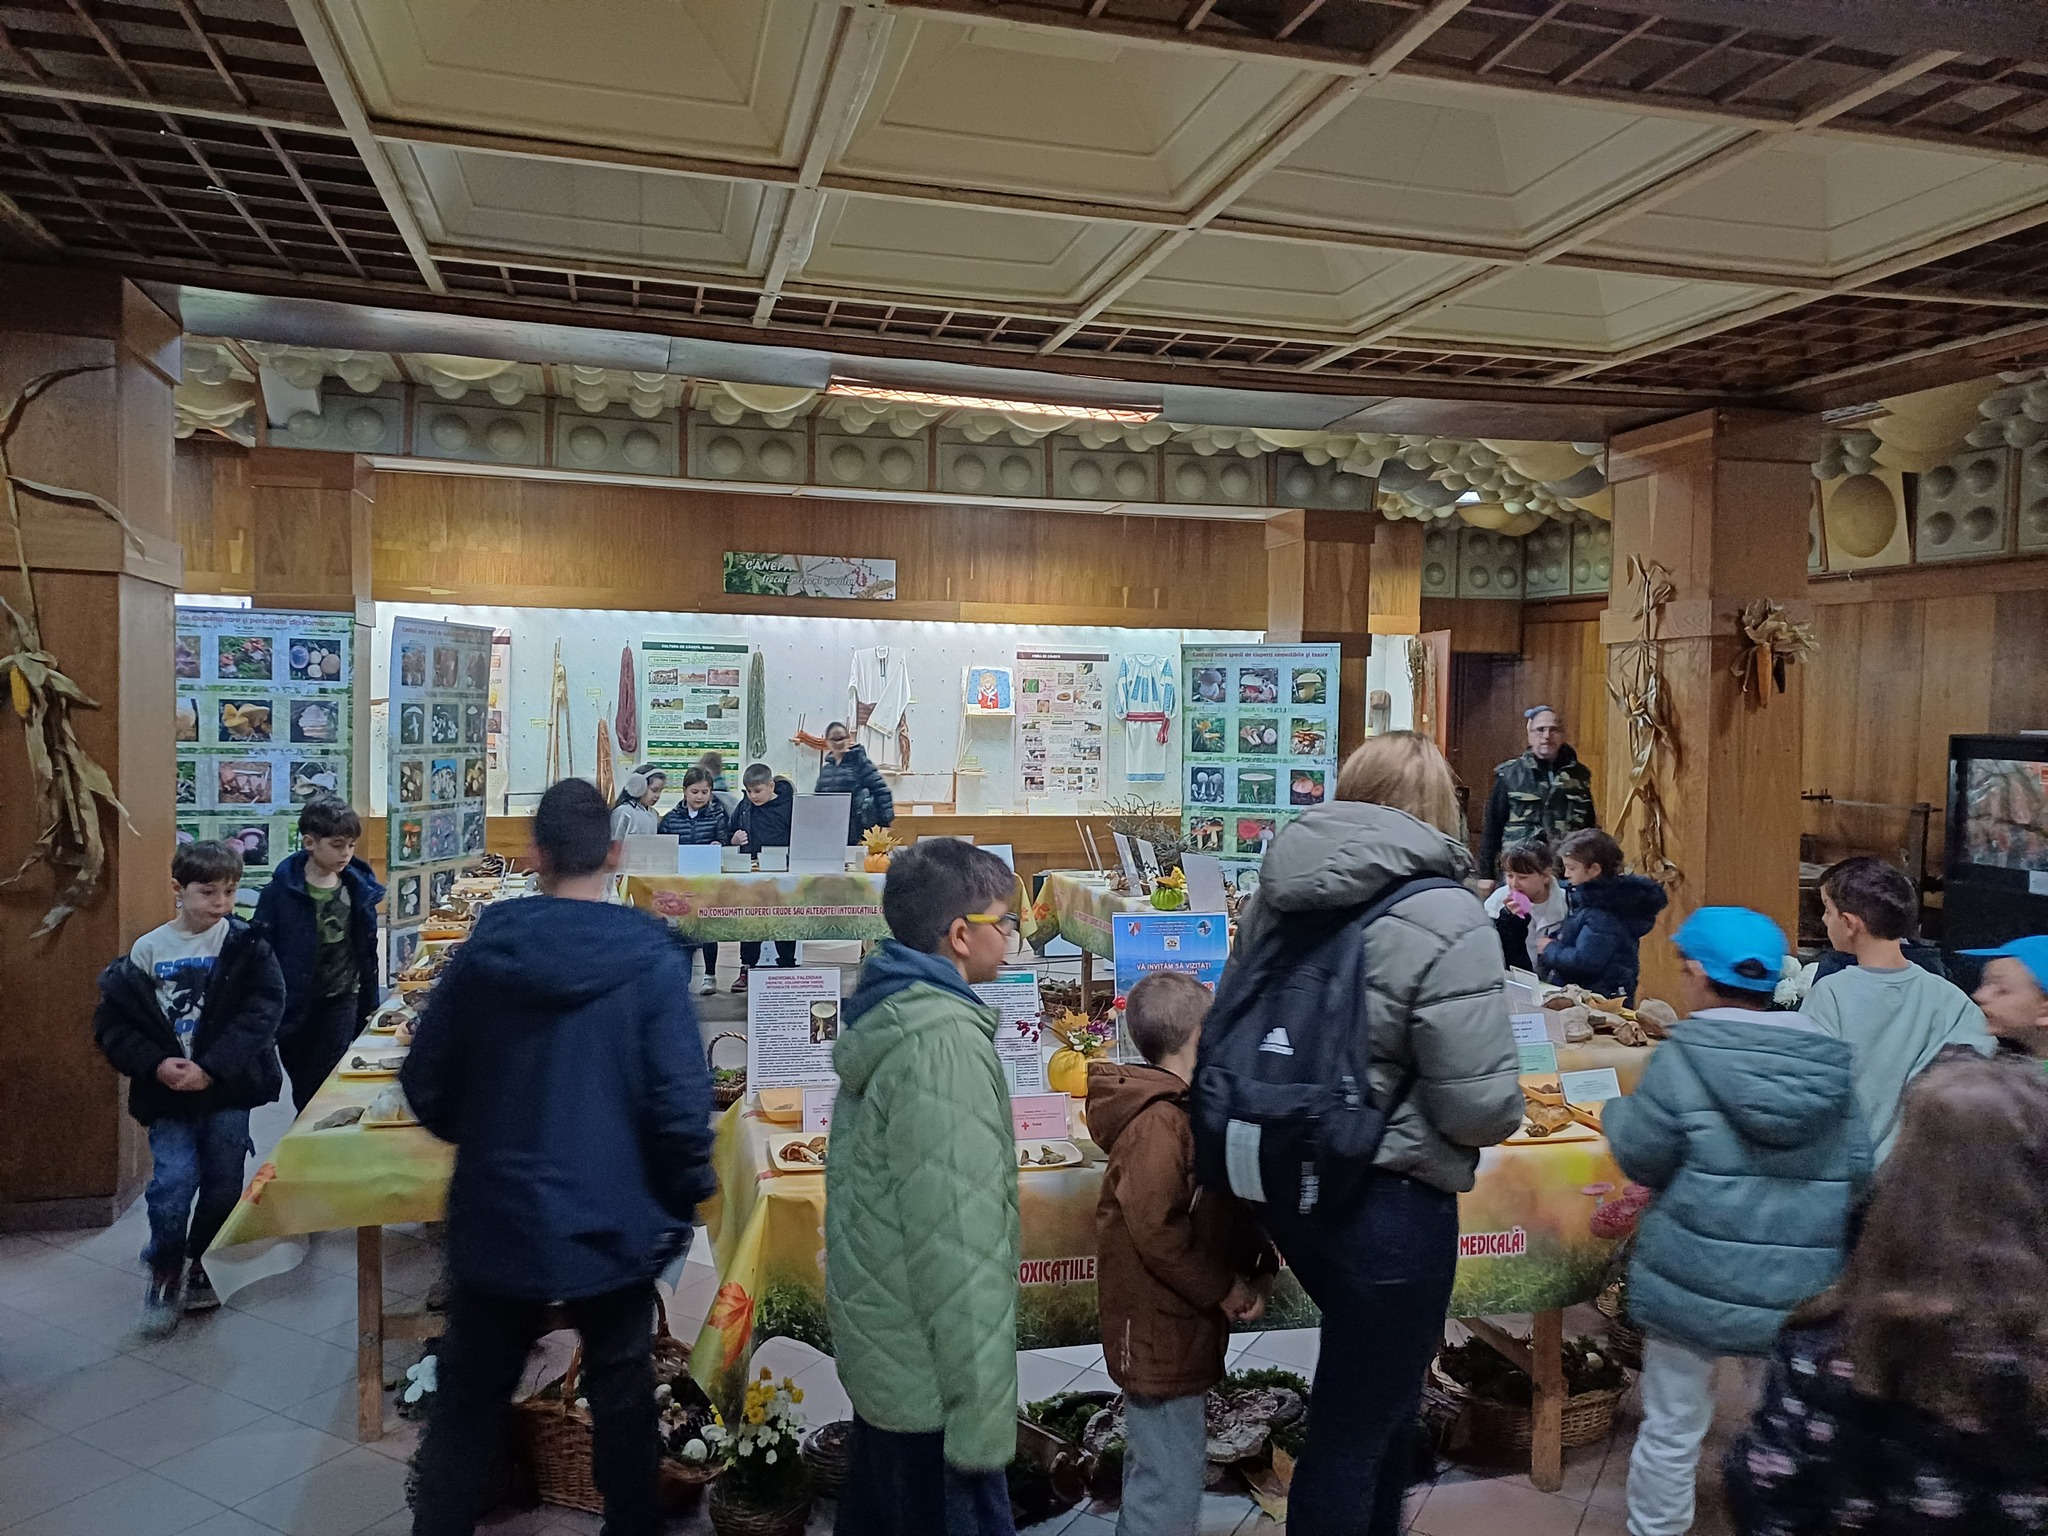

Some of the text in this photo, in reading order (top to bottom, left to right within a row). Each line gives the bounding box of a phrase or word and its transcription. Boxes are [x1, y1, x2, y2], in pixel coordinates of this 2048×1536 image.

[224, 616, 241, 624] rare
[699, 908, 708, 917] NU
[745, 907, 771, 916] CIUPERCI
[772, 907, 792, 916] CRUDE
[793, 907, 804, 916] SAU
[1019, 1228, 1524, 1287] OXICAȚIILE MEDICALĂ!
